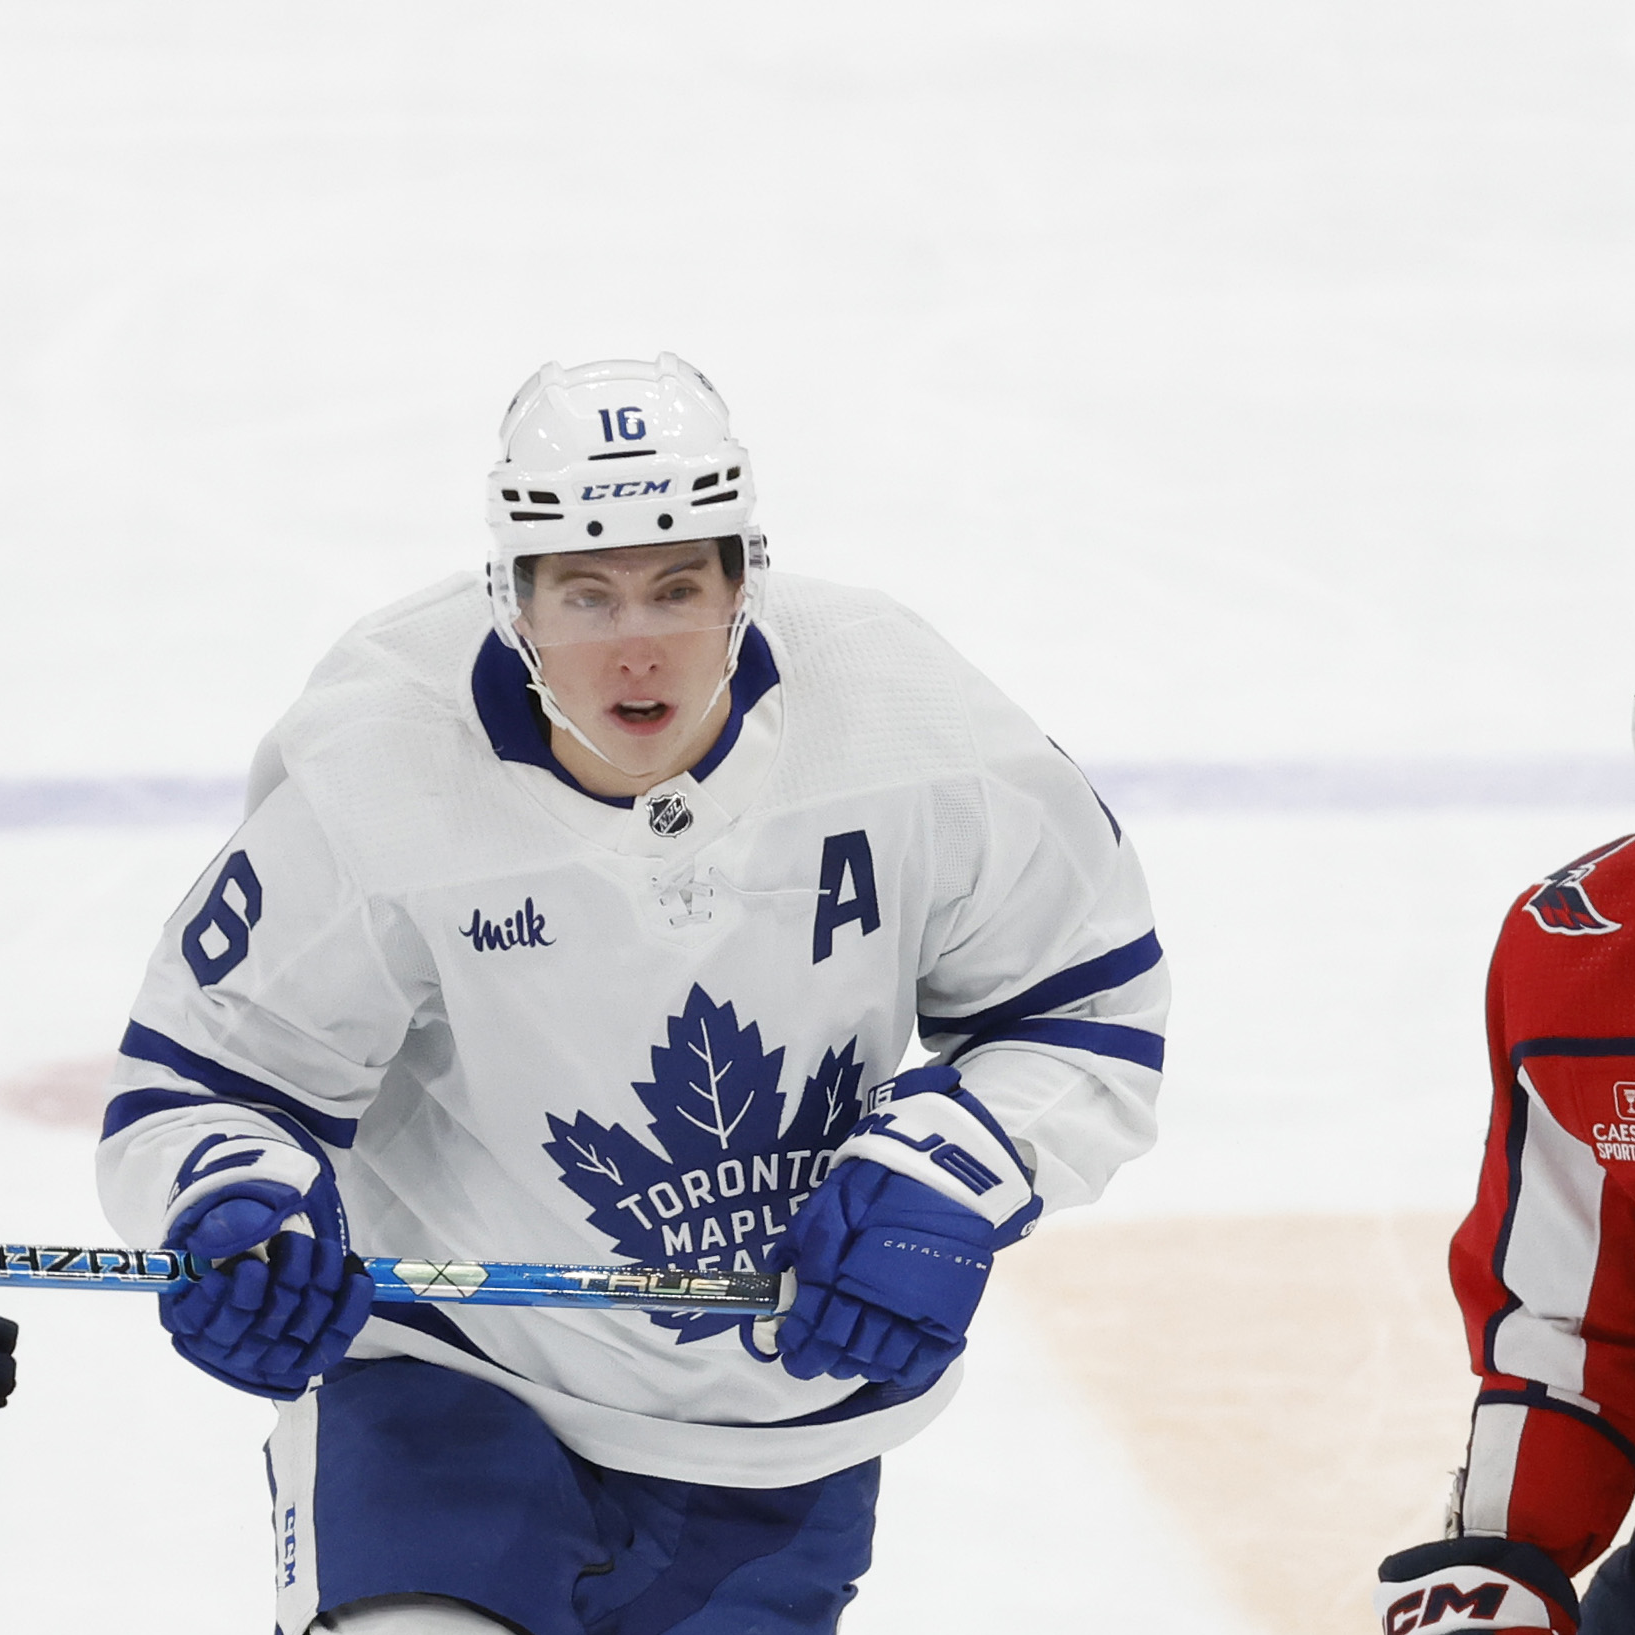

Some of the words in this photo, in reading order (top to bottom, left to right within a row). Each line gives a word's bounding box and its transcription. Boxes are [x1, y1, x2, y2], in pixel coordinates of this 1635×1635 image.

[598, 406, 646, 442] 16
[581, 478, 671, 501] CCM
[812, 829, 881, 965] A
[617, 1149, 837, 1230] TORONTO
[565, 1273, 730, 1296] TRUE
[283, 1502, 296, 1588] CCM
